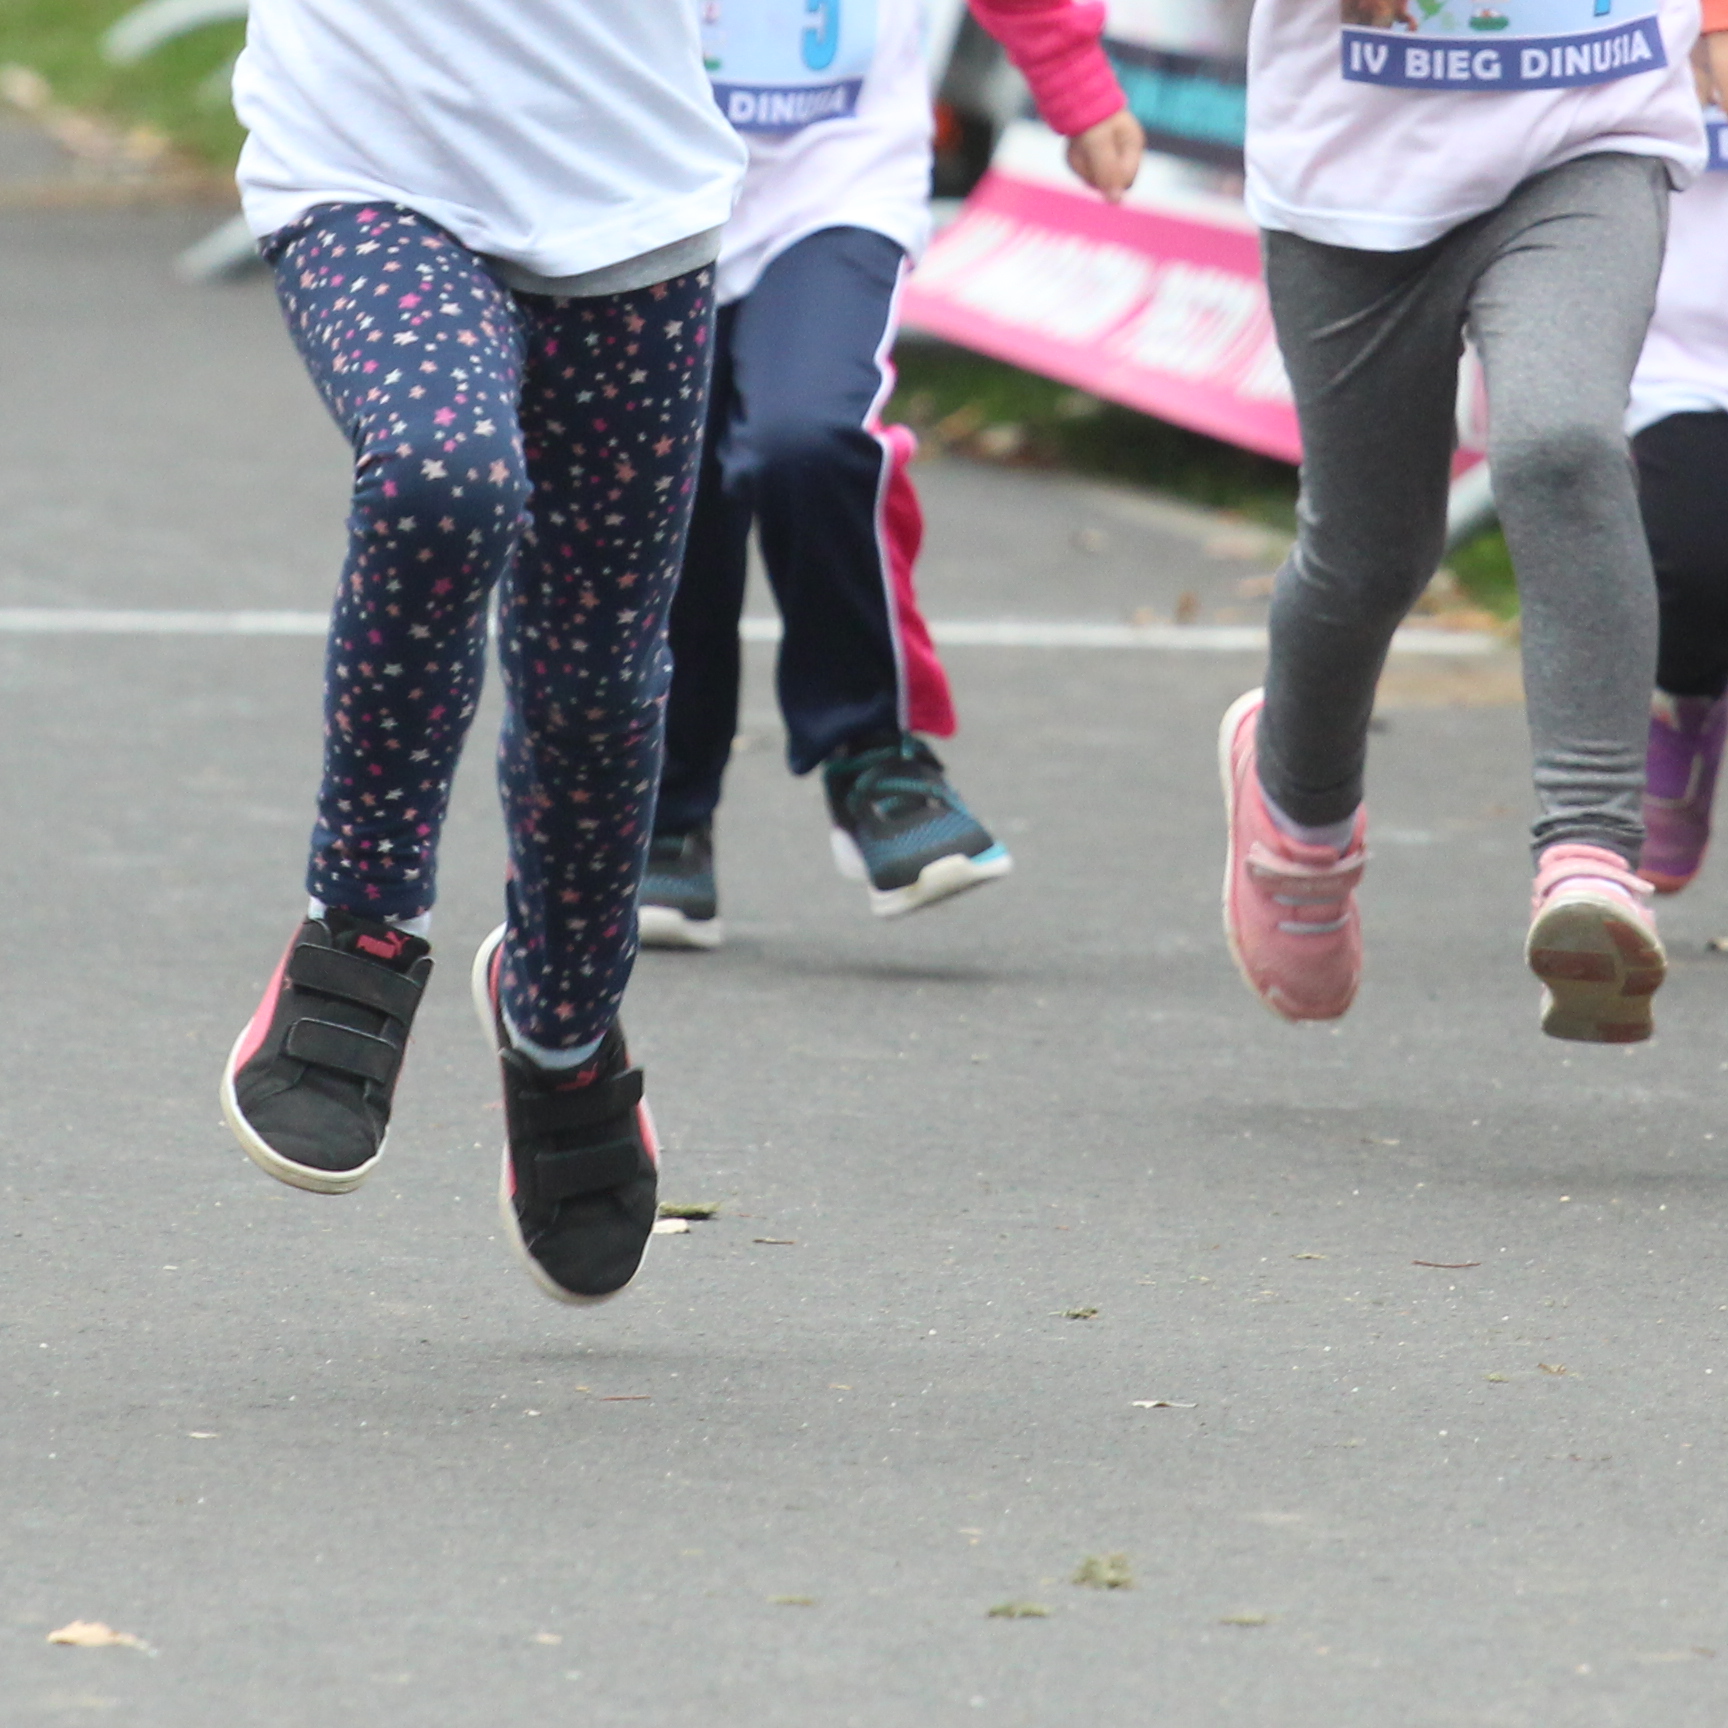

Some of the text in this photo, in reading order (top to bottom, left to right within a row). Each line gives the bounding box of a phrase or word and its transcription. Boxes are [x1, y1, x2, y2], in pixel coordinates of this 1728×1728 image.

[1350, 30, 1653, 80] IV BIEG DINUSIA
